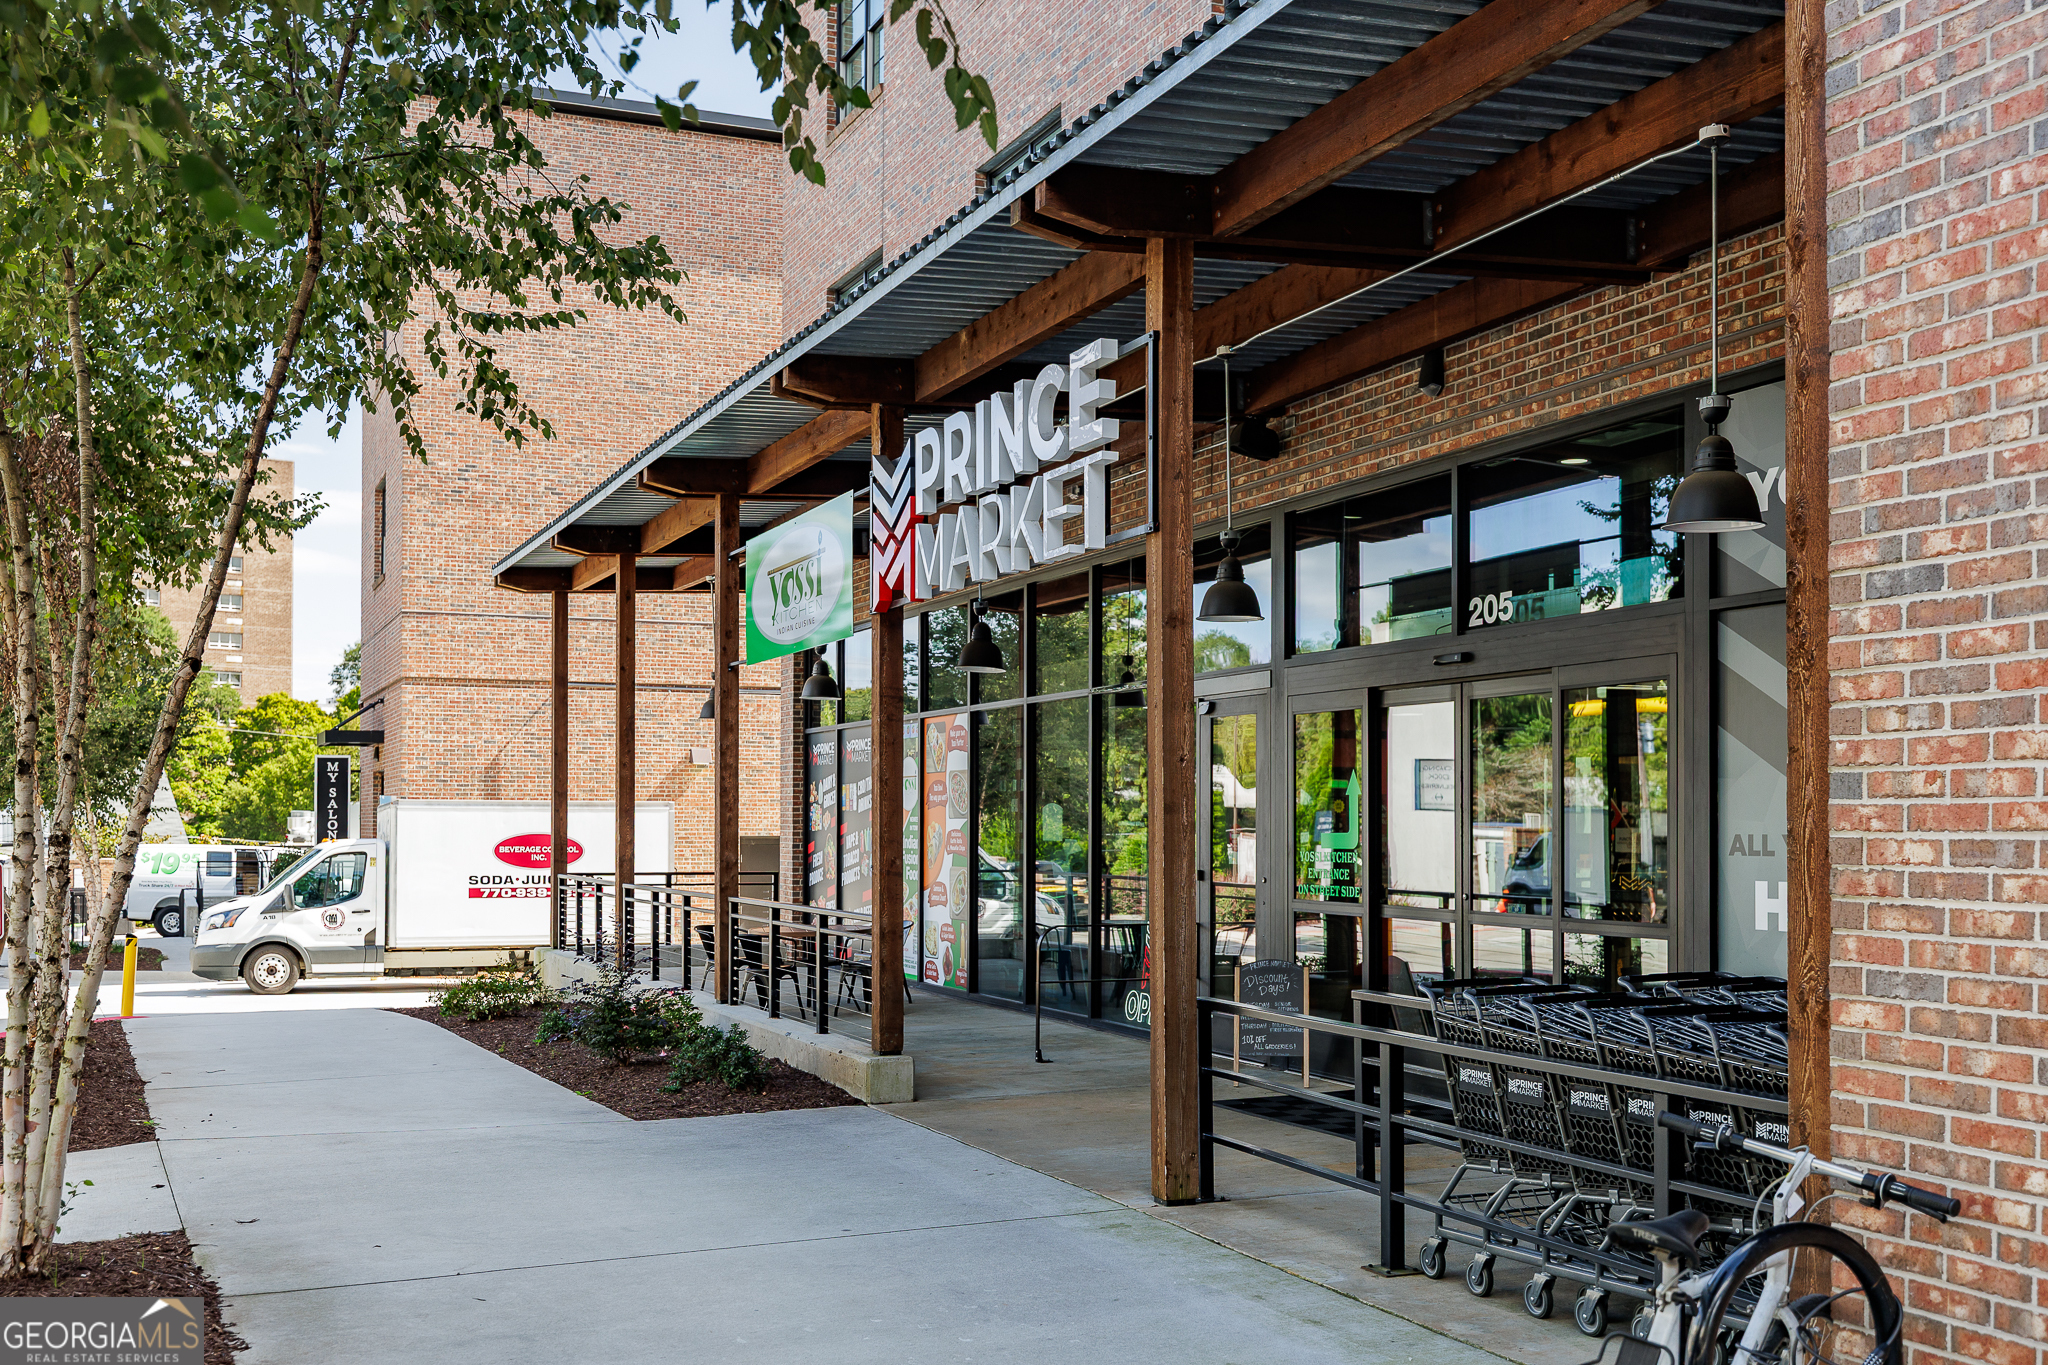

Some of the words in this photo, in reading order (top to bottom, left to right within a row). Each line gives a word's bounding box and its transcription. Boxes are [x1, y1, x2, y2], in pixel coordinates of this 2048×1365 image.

[914, 338, 1119, 516] PRINCE
[914, 451, 1119, 599] MARKET
[1469, 590, 1513, 627] 205
[776, 624, 794, 635] INDIAN
[794, 616, 815, 630] CUISINE
[818, 742, 834, 755] PRINCE
[851, 738, 871, 751] PRINCE
[327, 762, 339, 783] MY
[327, 787, 338, 839] SALON
[1728, 834, 1775, 856] ALL
[1300, 851, 1322, 863] YOSSI
[1324, 851, 1358, 863] KITCHEN
[468, 875, 514, 885] SODA
[521, 875, 551, 885] JUI
[1308, 867, 1350, 880] ENTRANCE
[1298, 884, 1309, 895] ON
[1309, 884, 1340, 897] STREET
[1341, 885, 1360, 898] SIDE
[1755, 880, 1788, 932] H
[1244, 973, 1288, 988] Discount
[1259, 982, 1290, 996] Days!
[1125, 990, 1151, 1025] OP
[1255, 1034, 1267, 1042] OFF
[1466, 1068, 1492, 1081] PRINCE
[1466, 1076, 1492, 1088] MARKET
[1515, 1078, 1543, 1091] PRINCE
[1515, 1087, 1543, 1098] MARKET
[1579, 1091, 1608, 1103] PRINCE
[1579, 1099, 1609, 1111] MARKET
[1637, 1108, 1654, 1118] MAR
[1699, 1110, 1733, 1125] PRINCE
[1766, 1122, 1789, 1134] PRIN
[1766, 1132, 1789, 1144] MAR
[1631, 1228, 1659, 1244] TREK
